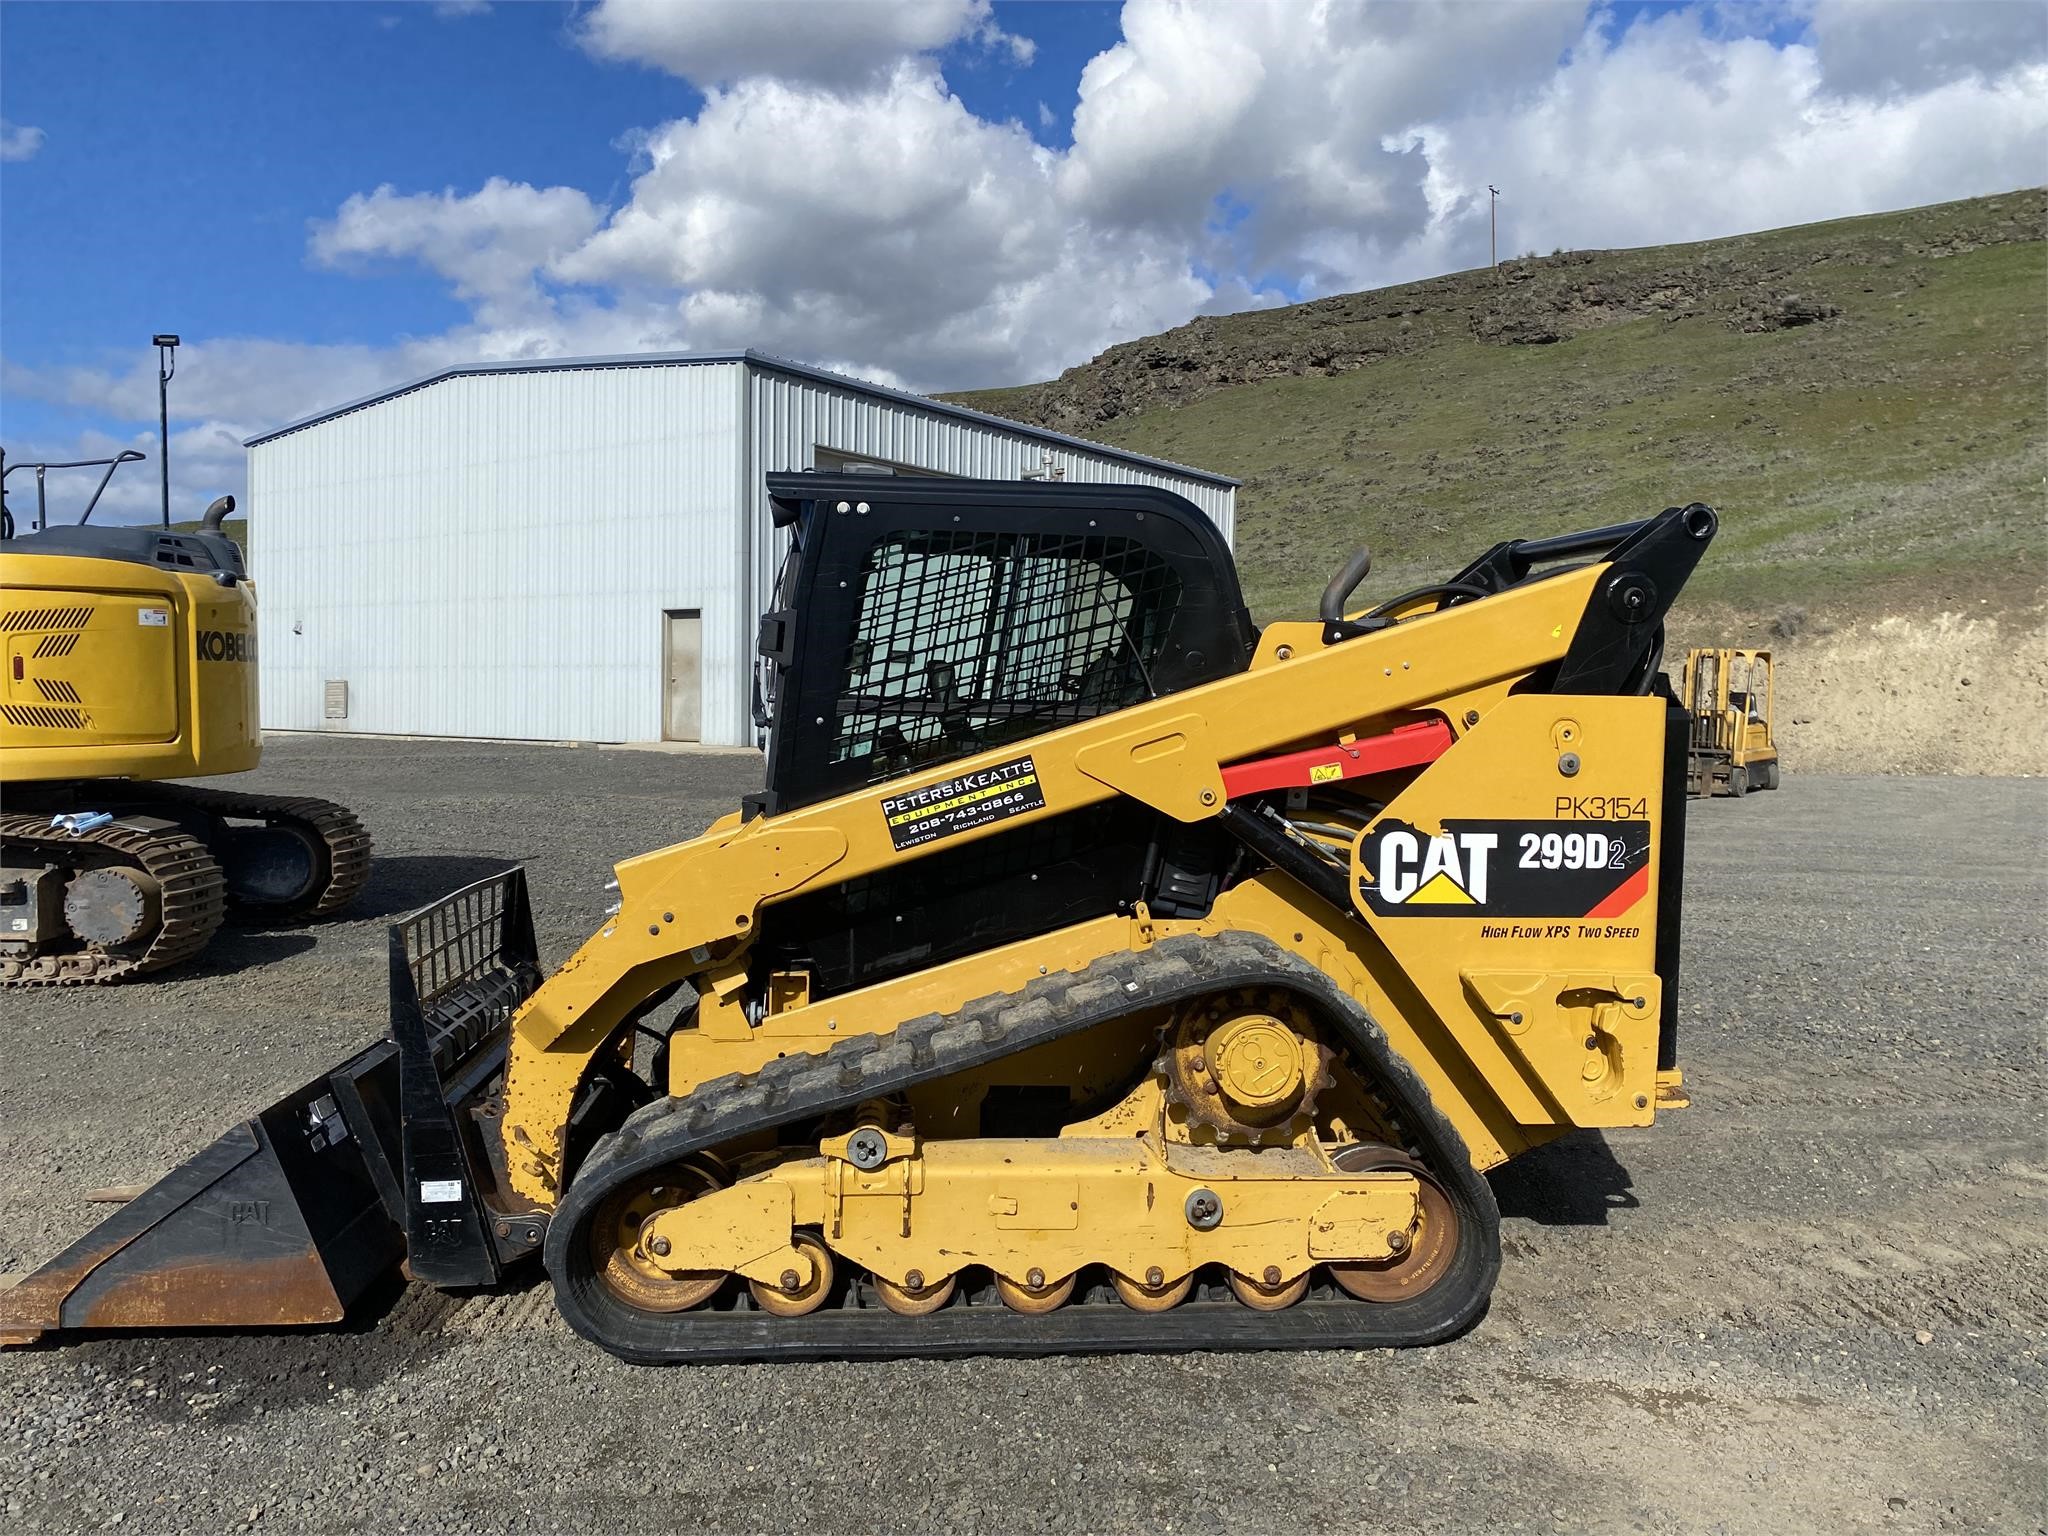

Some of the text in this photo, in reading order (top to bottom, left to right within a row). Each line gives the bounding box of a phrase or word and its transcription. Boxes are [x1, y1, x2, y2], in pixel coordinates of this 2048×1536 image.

[882, 760, 1034, 815] PETERS&KEATTS
[892, 777, 1035, 825] EQUIPMENT INC.
[1555, 796, 1648, 819] PK3154
[895, 799, 1045, 849] LEWISTON RICHLAND SEATTLE
[909, 792, 1025, 835] 208-743-0866
[1379, 830, 1626, 905] CAT 299D2
[1480, 925, 1640, 939] HIGH FLOW XPS TWO SPEED
[230, 1200, 271, 1225] CAT
